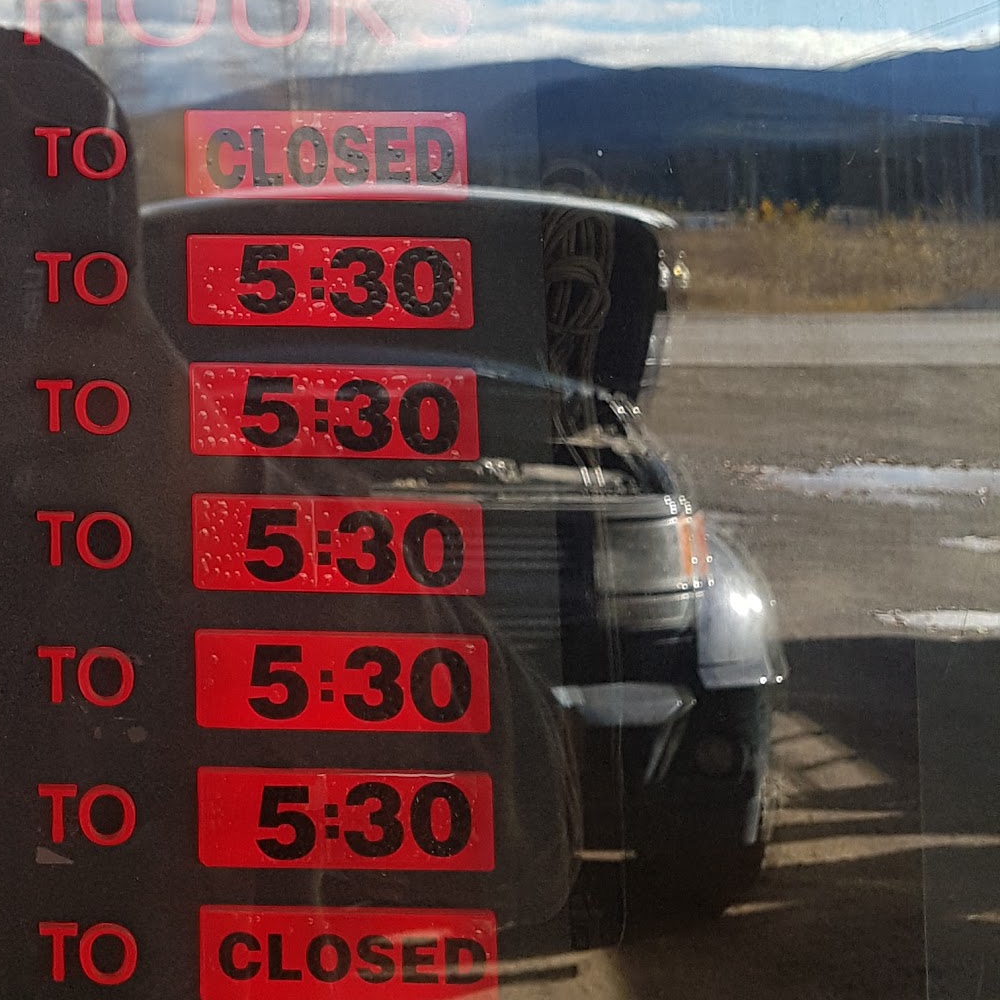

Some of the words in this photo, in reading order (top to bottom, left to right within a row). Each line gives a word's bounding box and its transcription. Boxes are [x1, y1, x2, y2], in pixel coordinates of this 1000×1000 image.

[34, 125, 128, 180] TO
[205, 126, 456, 189] CLOSED
[34, 251, 129, 306] TO
[236, 244, 455, 318] 5:30
[35, 379, 131, 435] TO
[239, 375, 460, 455] 5:30
[36, 510, 133, 569] TO
[243, 507, 465, 588] 5:30
[37, 645, 135, 706] TO
[247, 643, 472, 724] 5:30
[37, 783, 137, 846] TO
[254, 781, 472, 861] 5:30
[38, 921, 138, 986] TO
[217, 930, 487, 985] CLOSED
